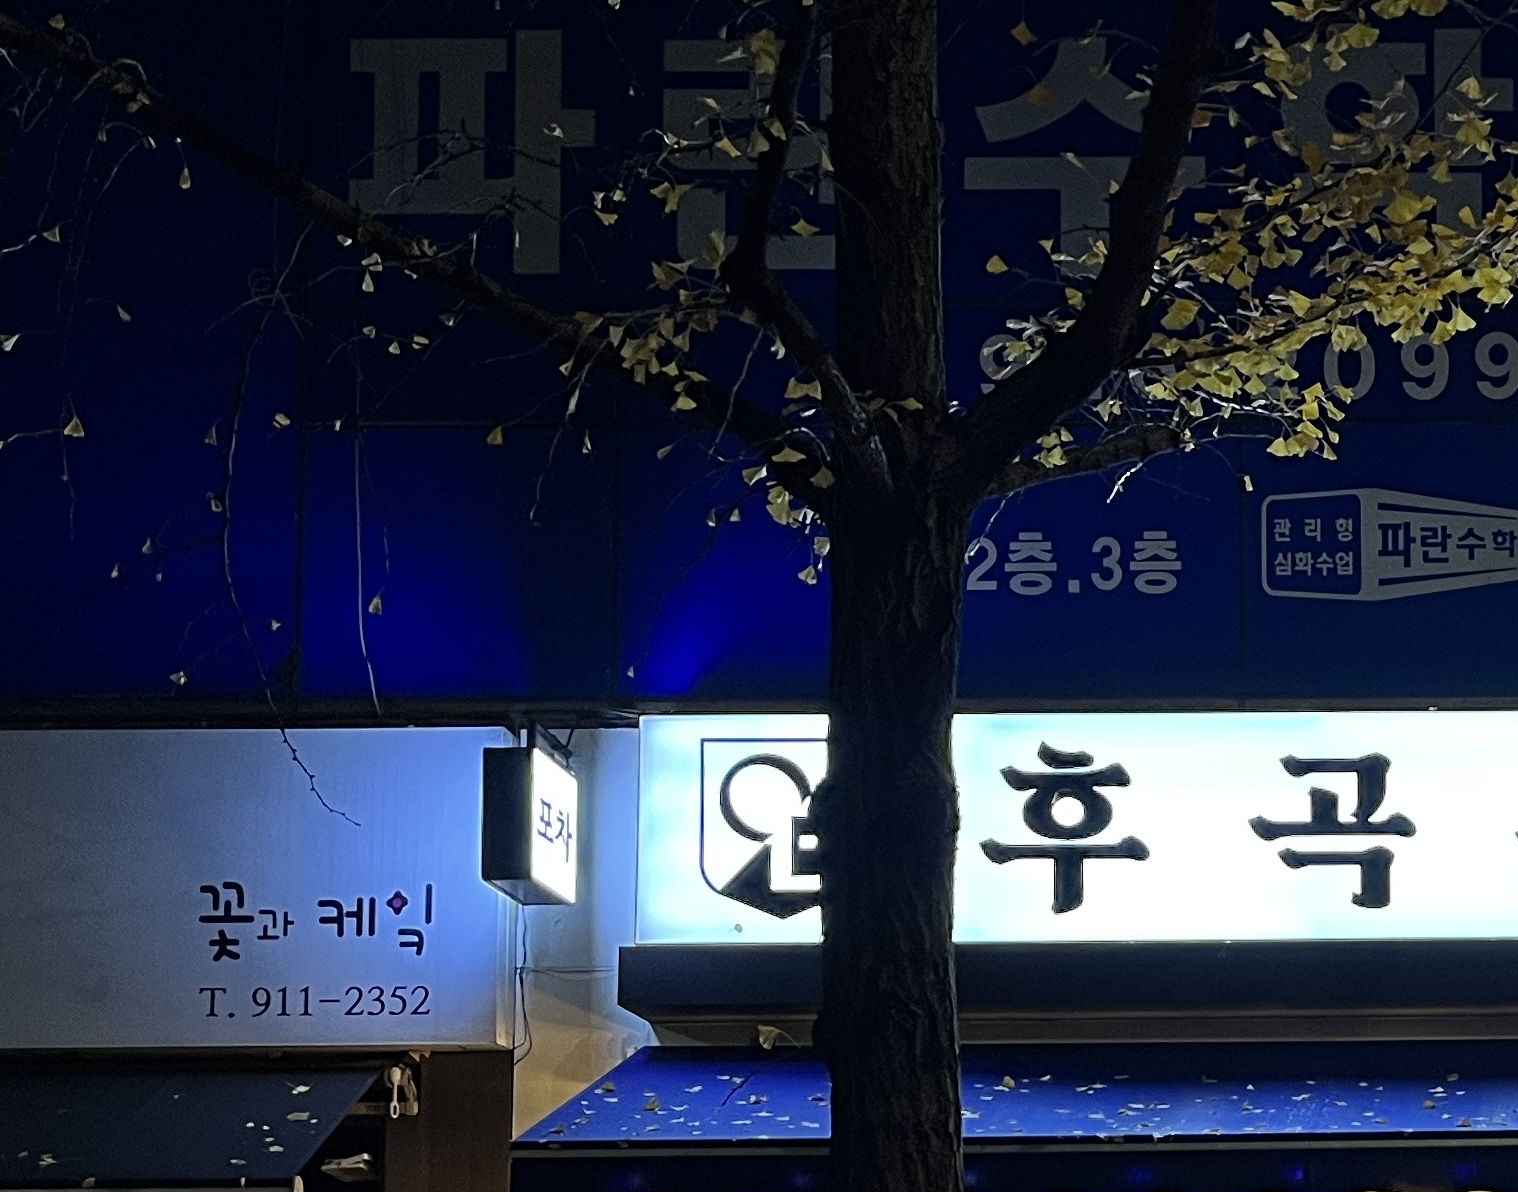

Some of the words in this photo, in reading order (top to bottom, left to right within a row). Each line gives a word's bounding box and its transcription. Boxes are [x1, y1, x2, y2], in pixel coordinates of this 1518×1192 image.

[1274, 552, 1354, 577] 심화수업
[1377, 522, 1518, 568] 파란수학
[537, 797, 573, 864] 포차
[199, 881, 294, 962] 꽃과
[317, 883, 433, 956] 케익
[198, 987, 236, 1018] T.
[251, 985, 431, 1017] 911-2352
